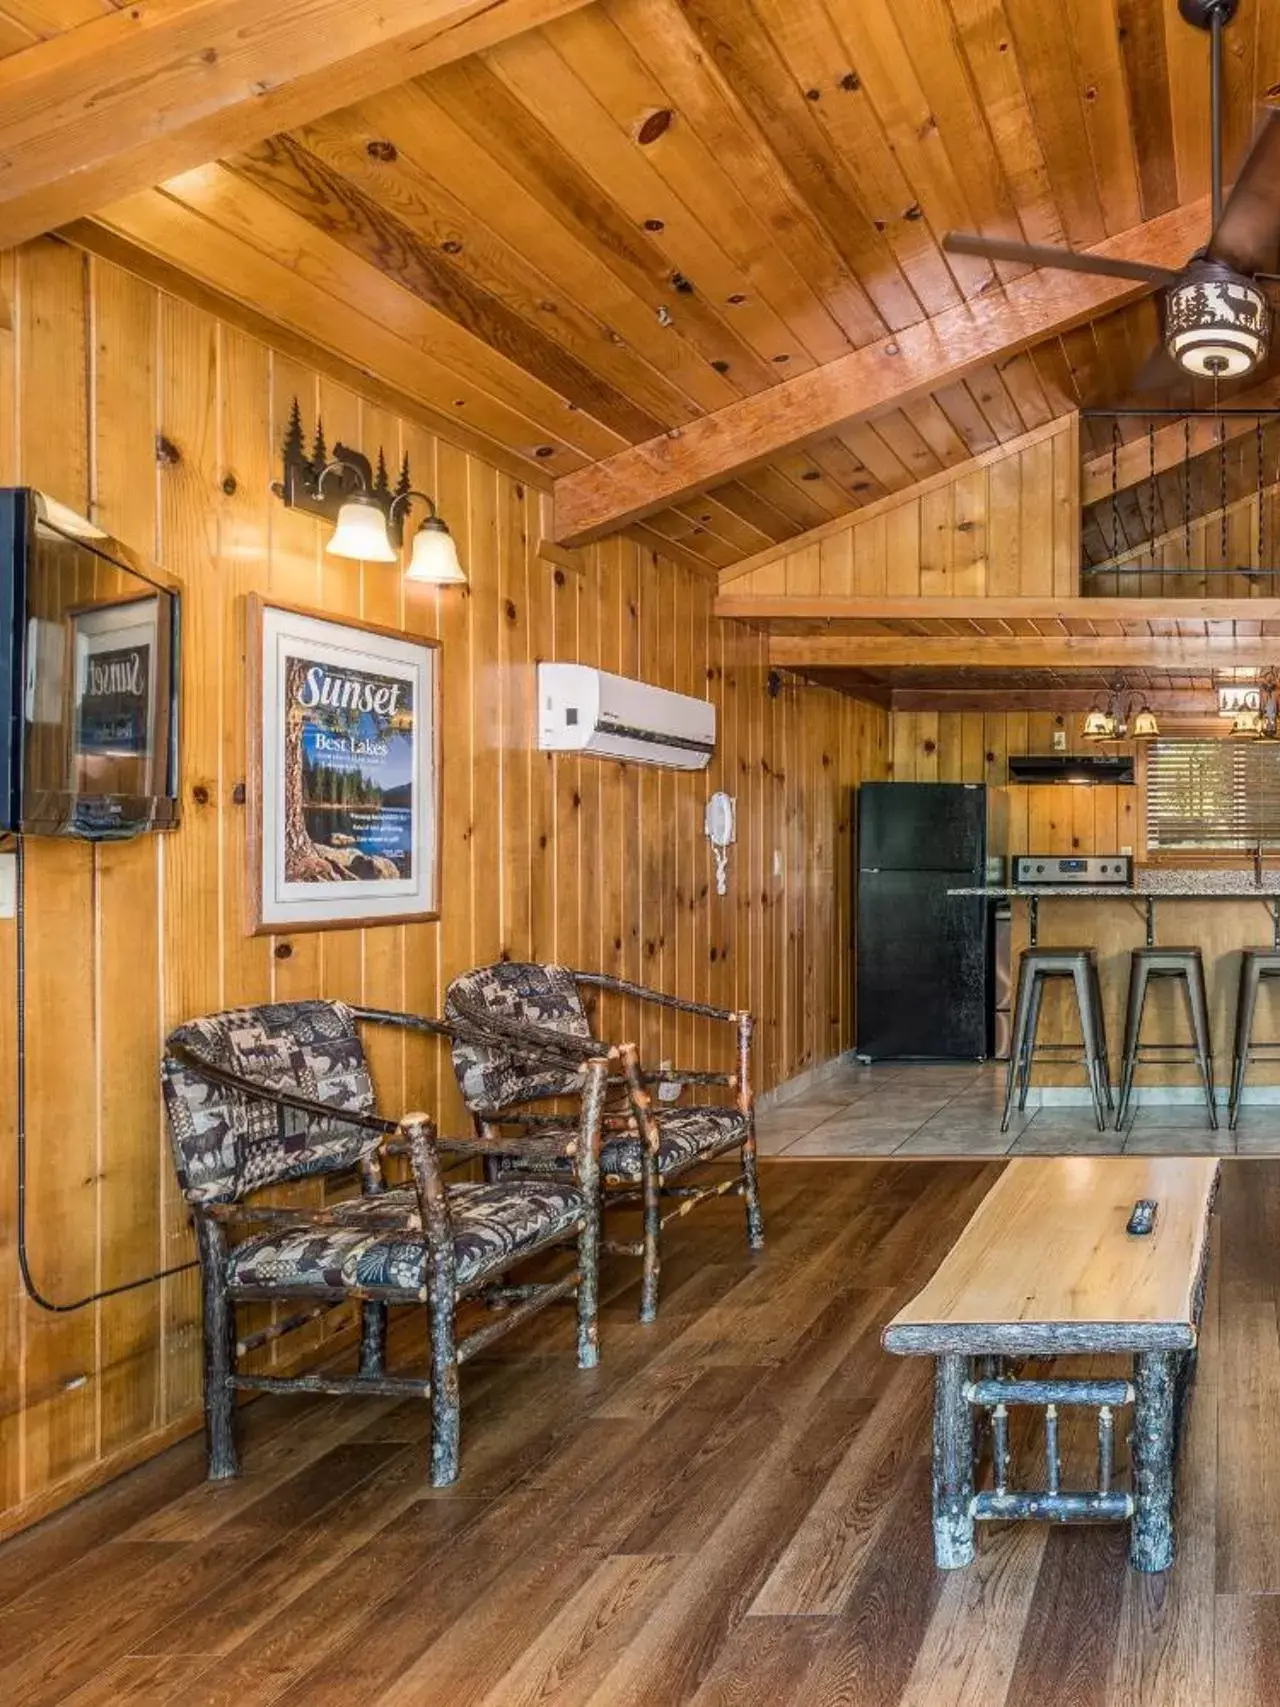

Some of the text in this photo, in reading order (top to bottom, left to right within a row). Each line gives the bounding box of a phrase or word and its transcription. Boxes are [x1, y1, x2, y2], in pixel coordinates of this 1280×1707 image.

[298, 667, 400, 716] Sunset
[315, 733, 388, 757] Best Lakes
